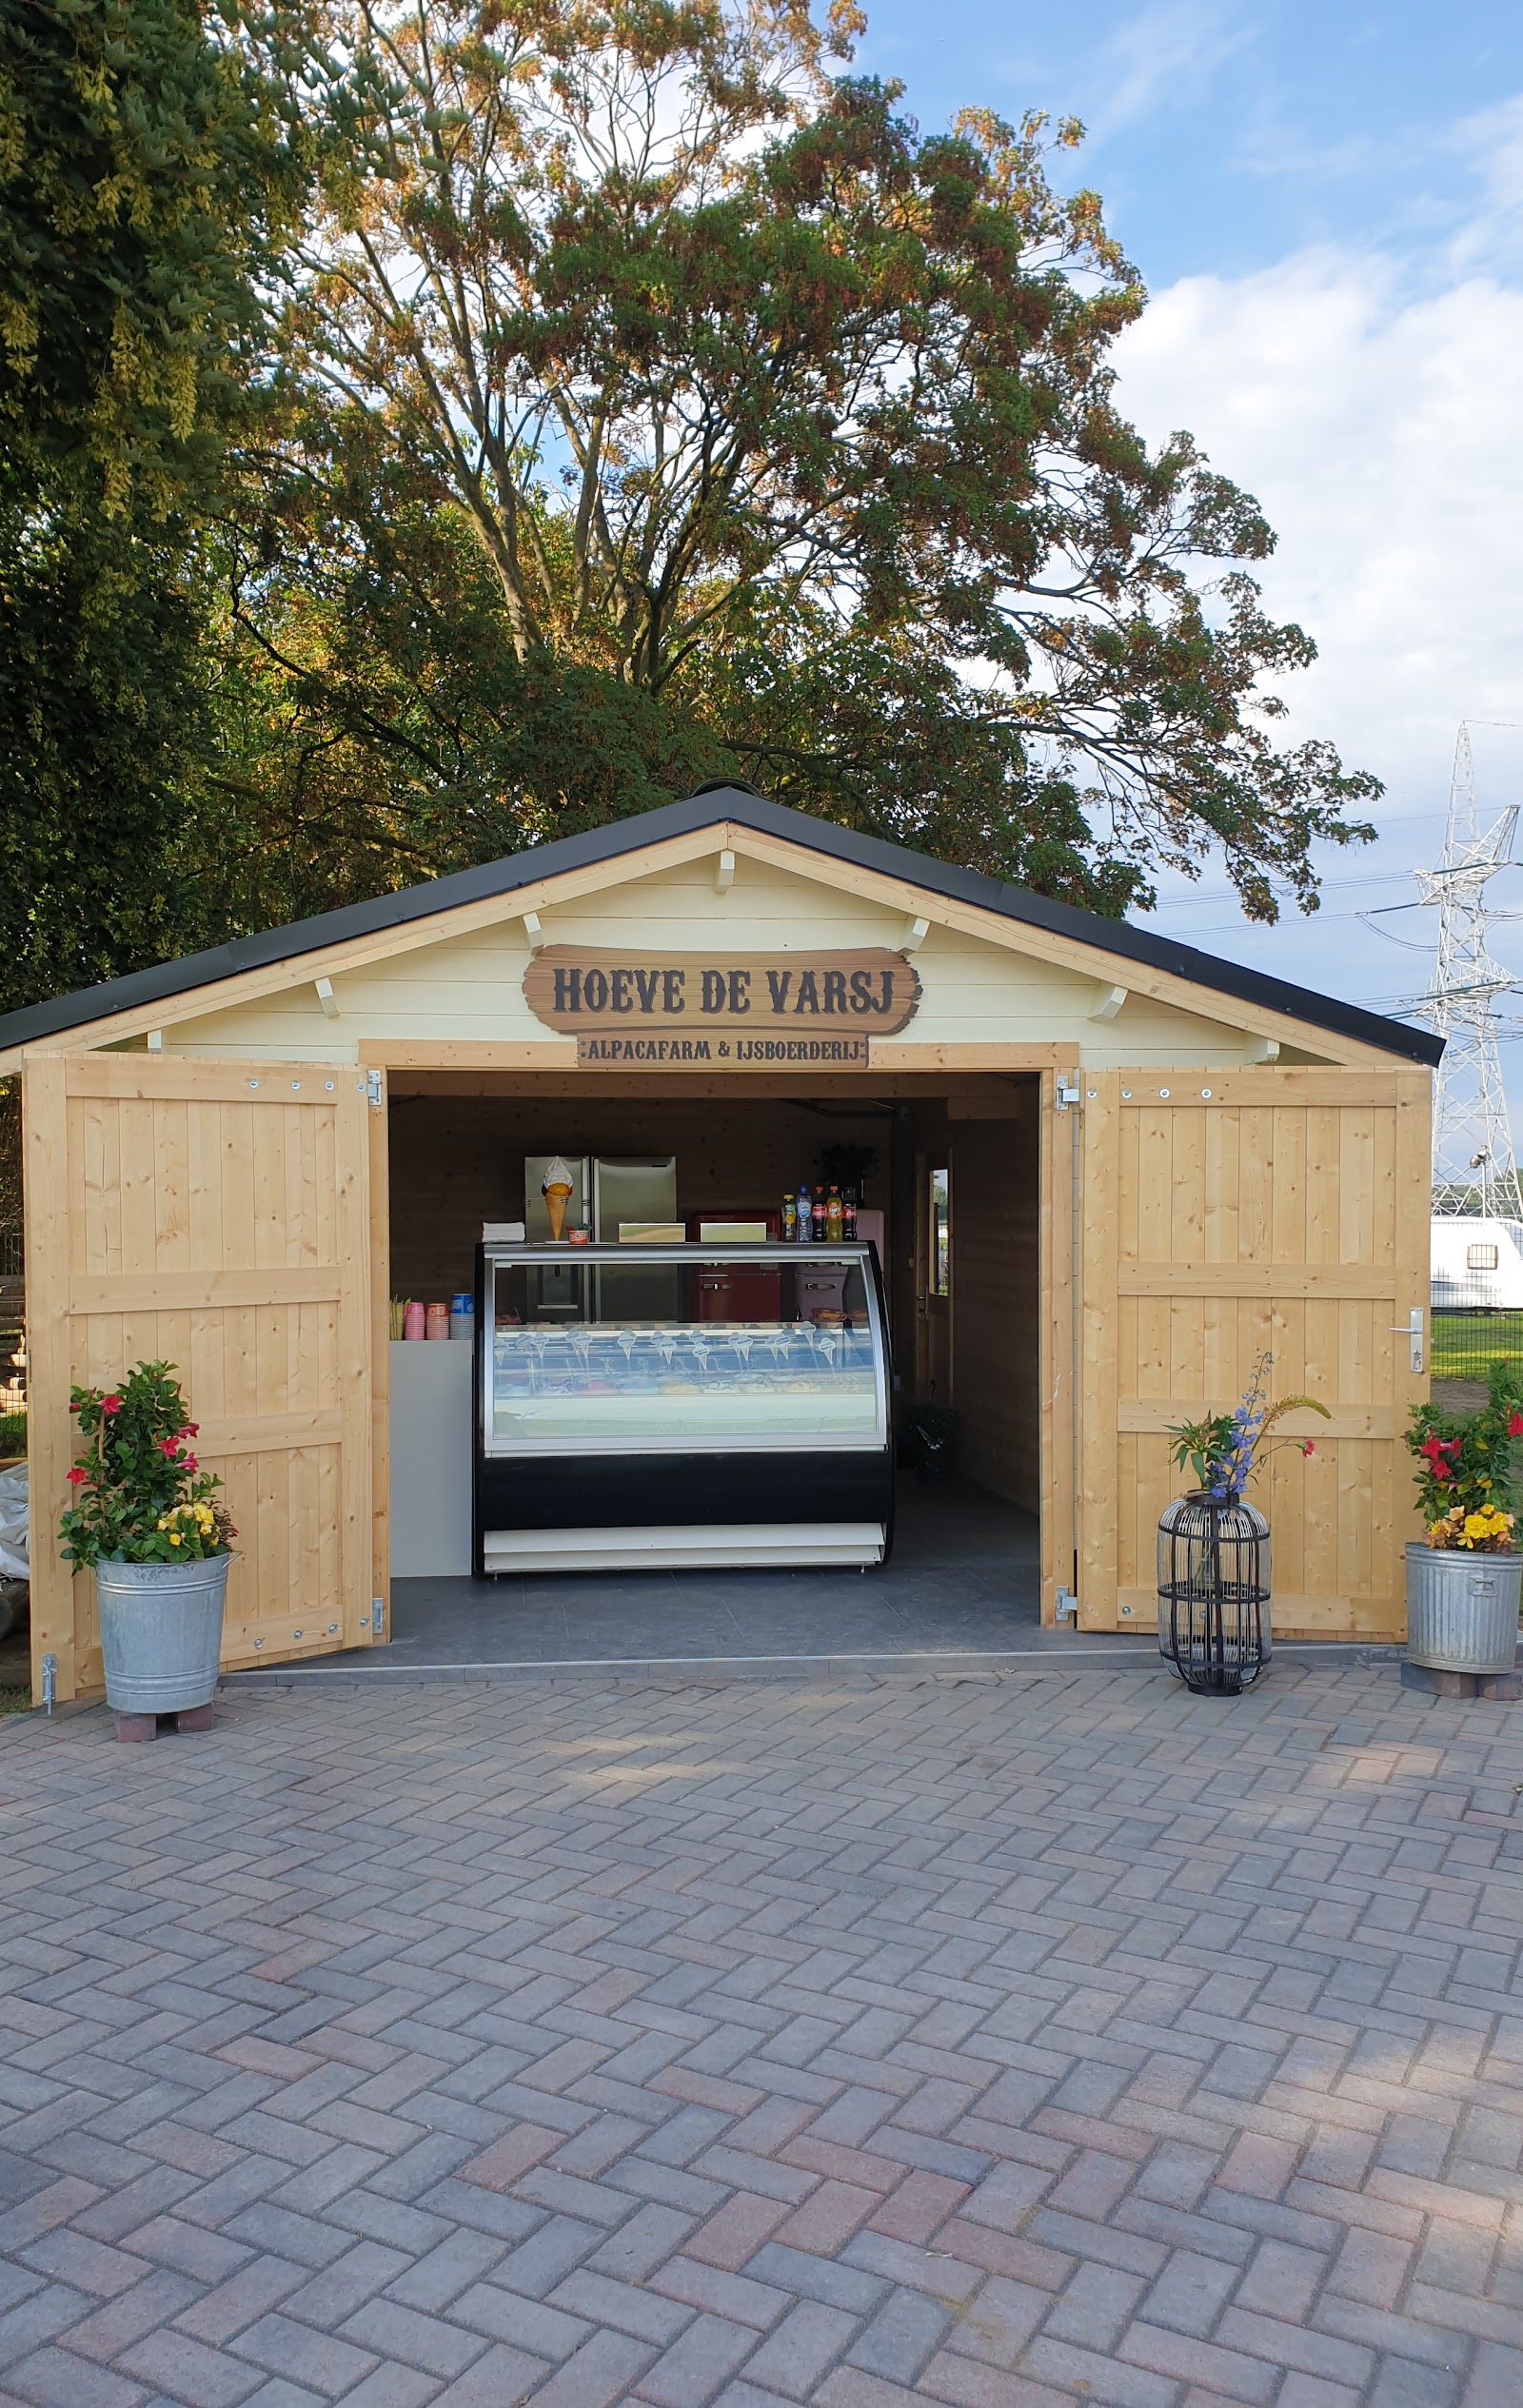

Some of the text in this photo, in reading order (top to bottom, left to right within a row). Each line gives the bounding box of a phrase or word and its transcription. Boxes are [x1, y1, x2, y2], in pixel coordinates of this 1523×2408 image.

[552, 968, 896, 1015] HOEVE DE VARSJ
[587, 1040, 860, 1060] ALPACAFARM & IJSBOERDERIJ
